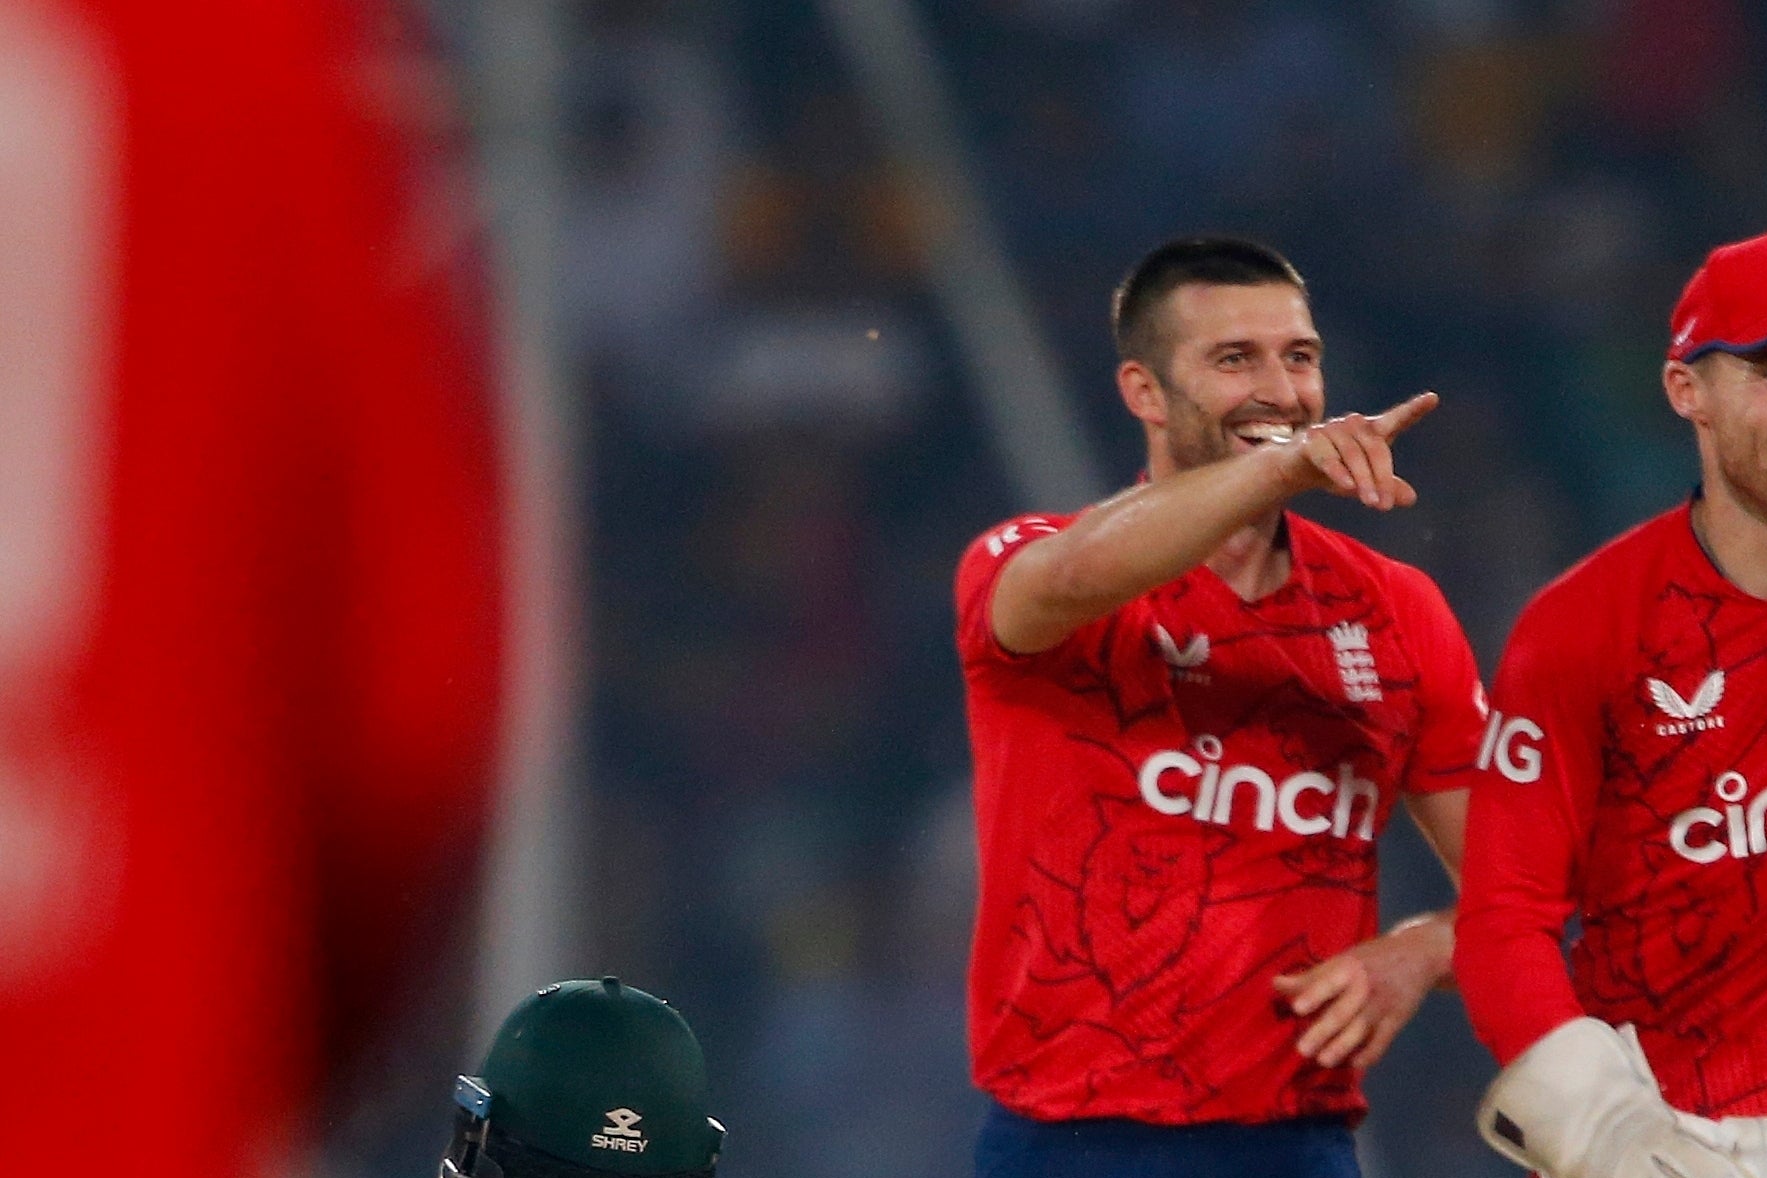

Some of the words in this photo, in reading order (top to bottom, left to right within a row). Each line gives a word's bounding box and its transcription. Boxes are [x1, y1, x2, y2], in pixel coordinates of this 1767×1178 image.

[1477, 710, 1545, 783] IG
[1656, 715, 1725, 736] CASTORE
[1139, 734, 1378, 841] cinch
[591, 1134, 648, 1153] SHREY
